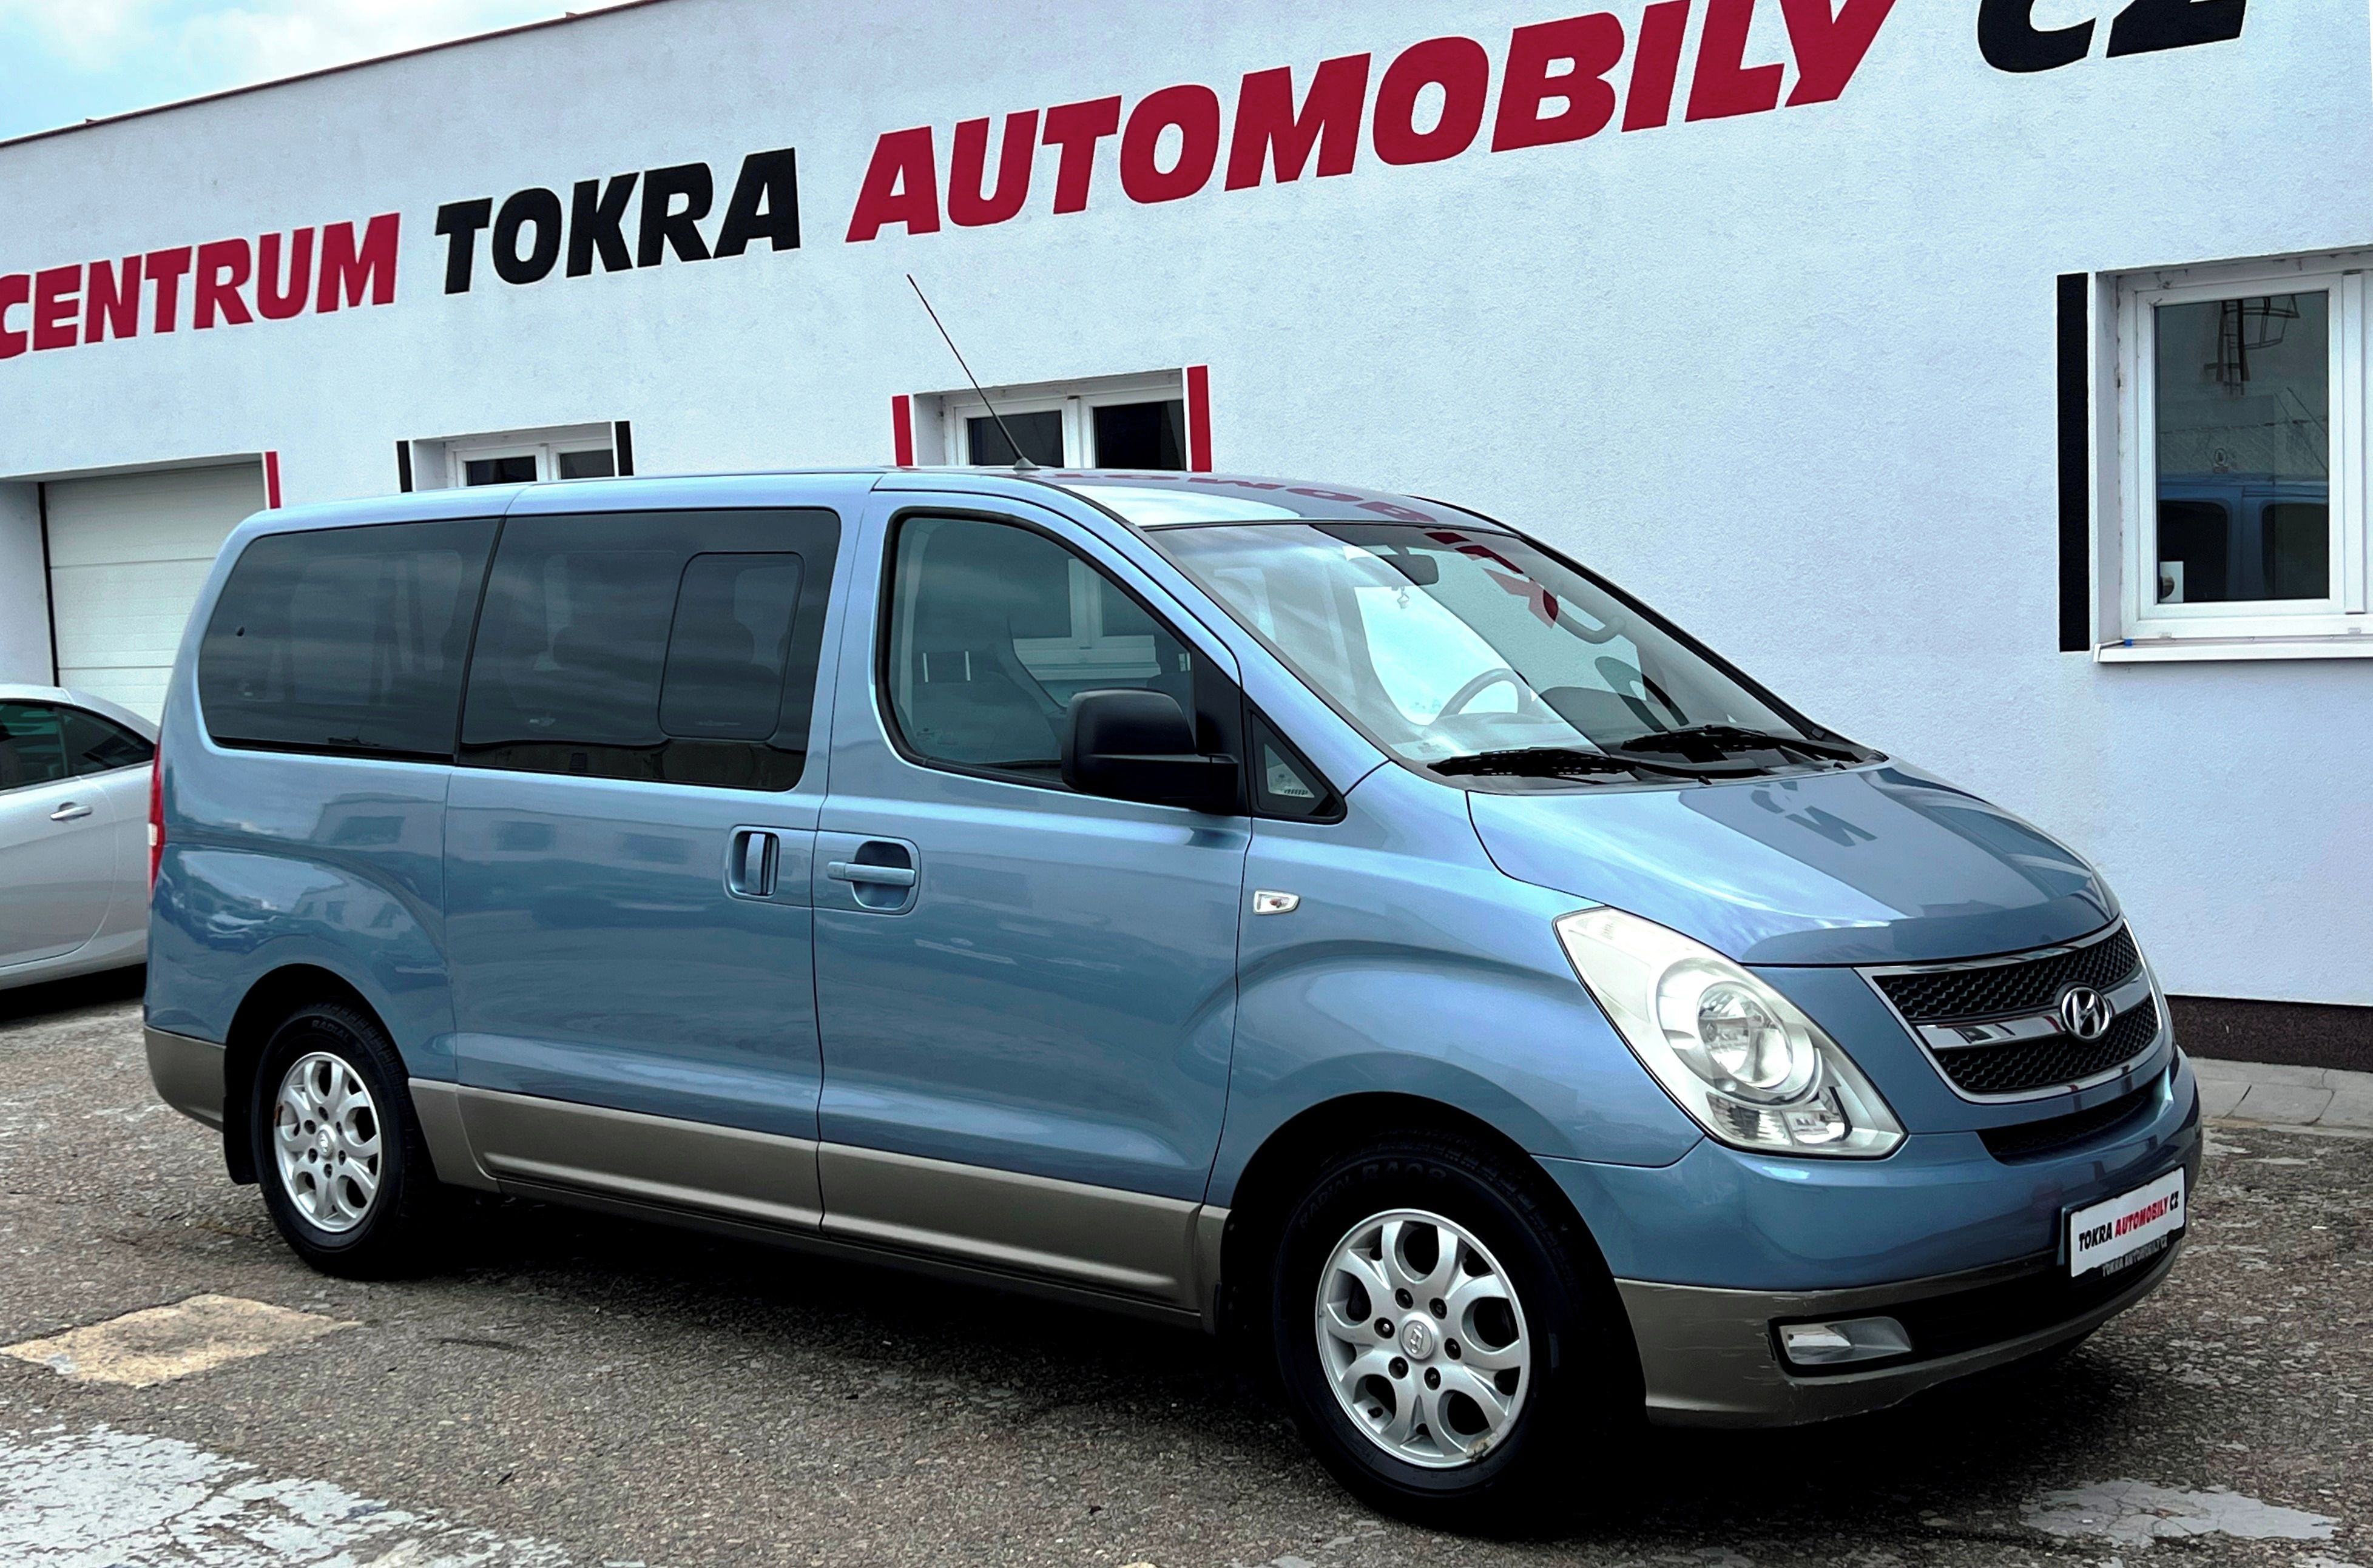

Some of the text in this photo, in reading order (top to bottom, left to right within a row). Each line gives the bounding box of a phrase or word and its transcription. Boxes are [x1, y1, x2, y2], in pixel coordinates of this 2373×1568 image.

[0, 212, 400, 359] CENTRUM
[435, 147, 801, 295] TOKRA
[845, 0, 1898, 243] AUTOMOBILY
[2079, 1190, 2179, 1251] TOKRA AUTOMOBILY CZ
